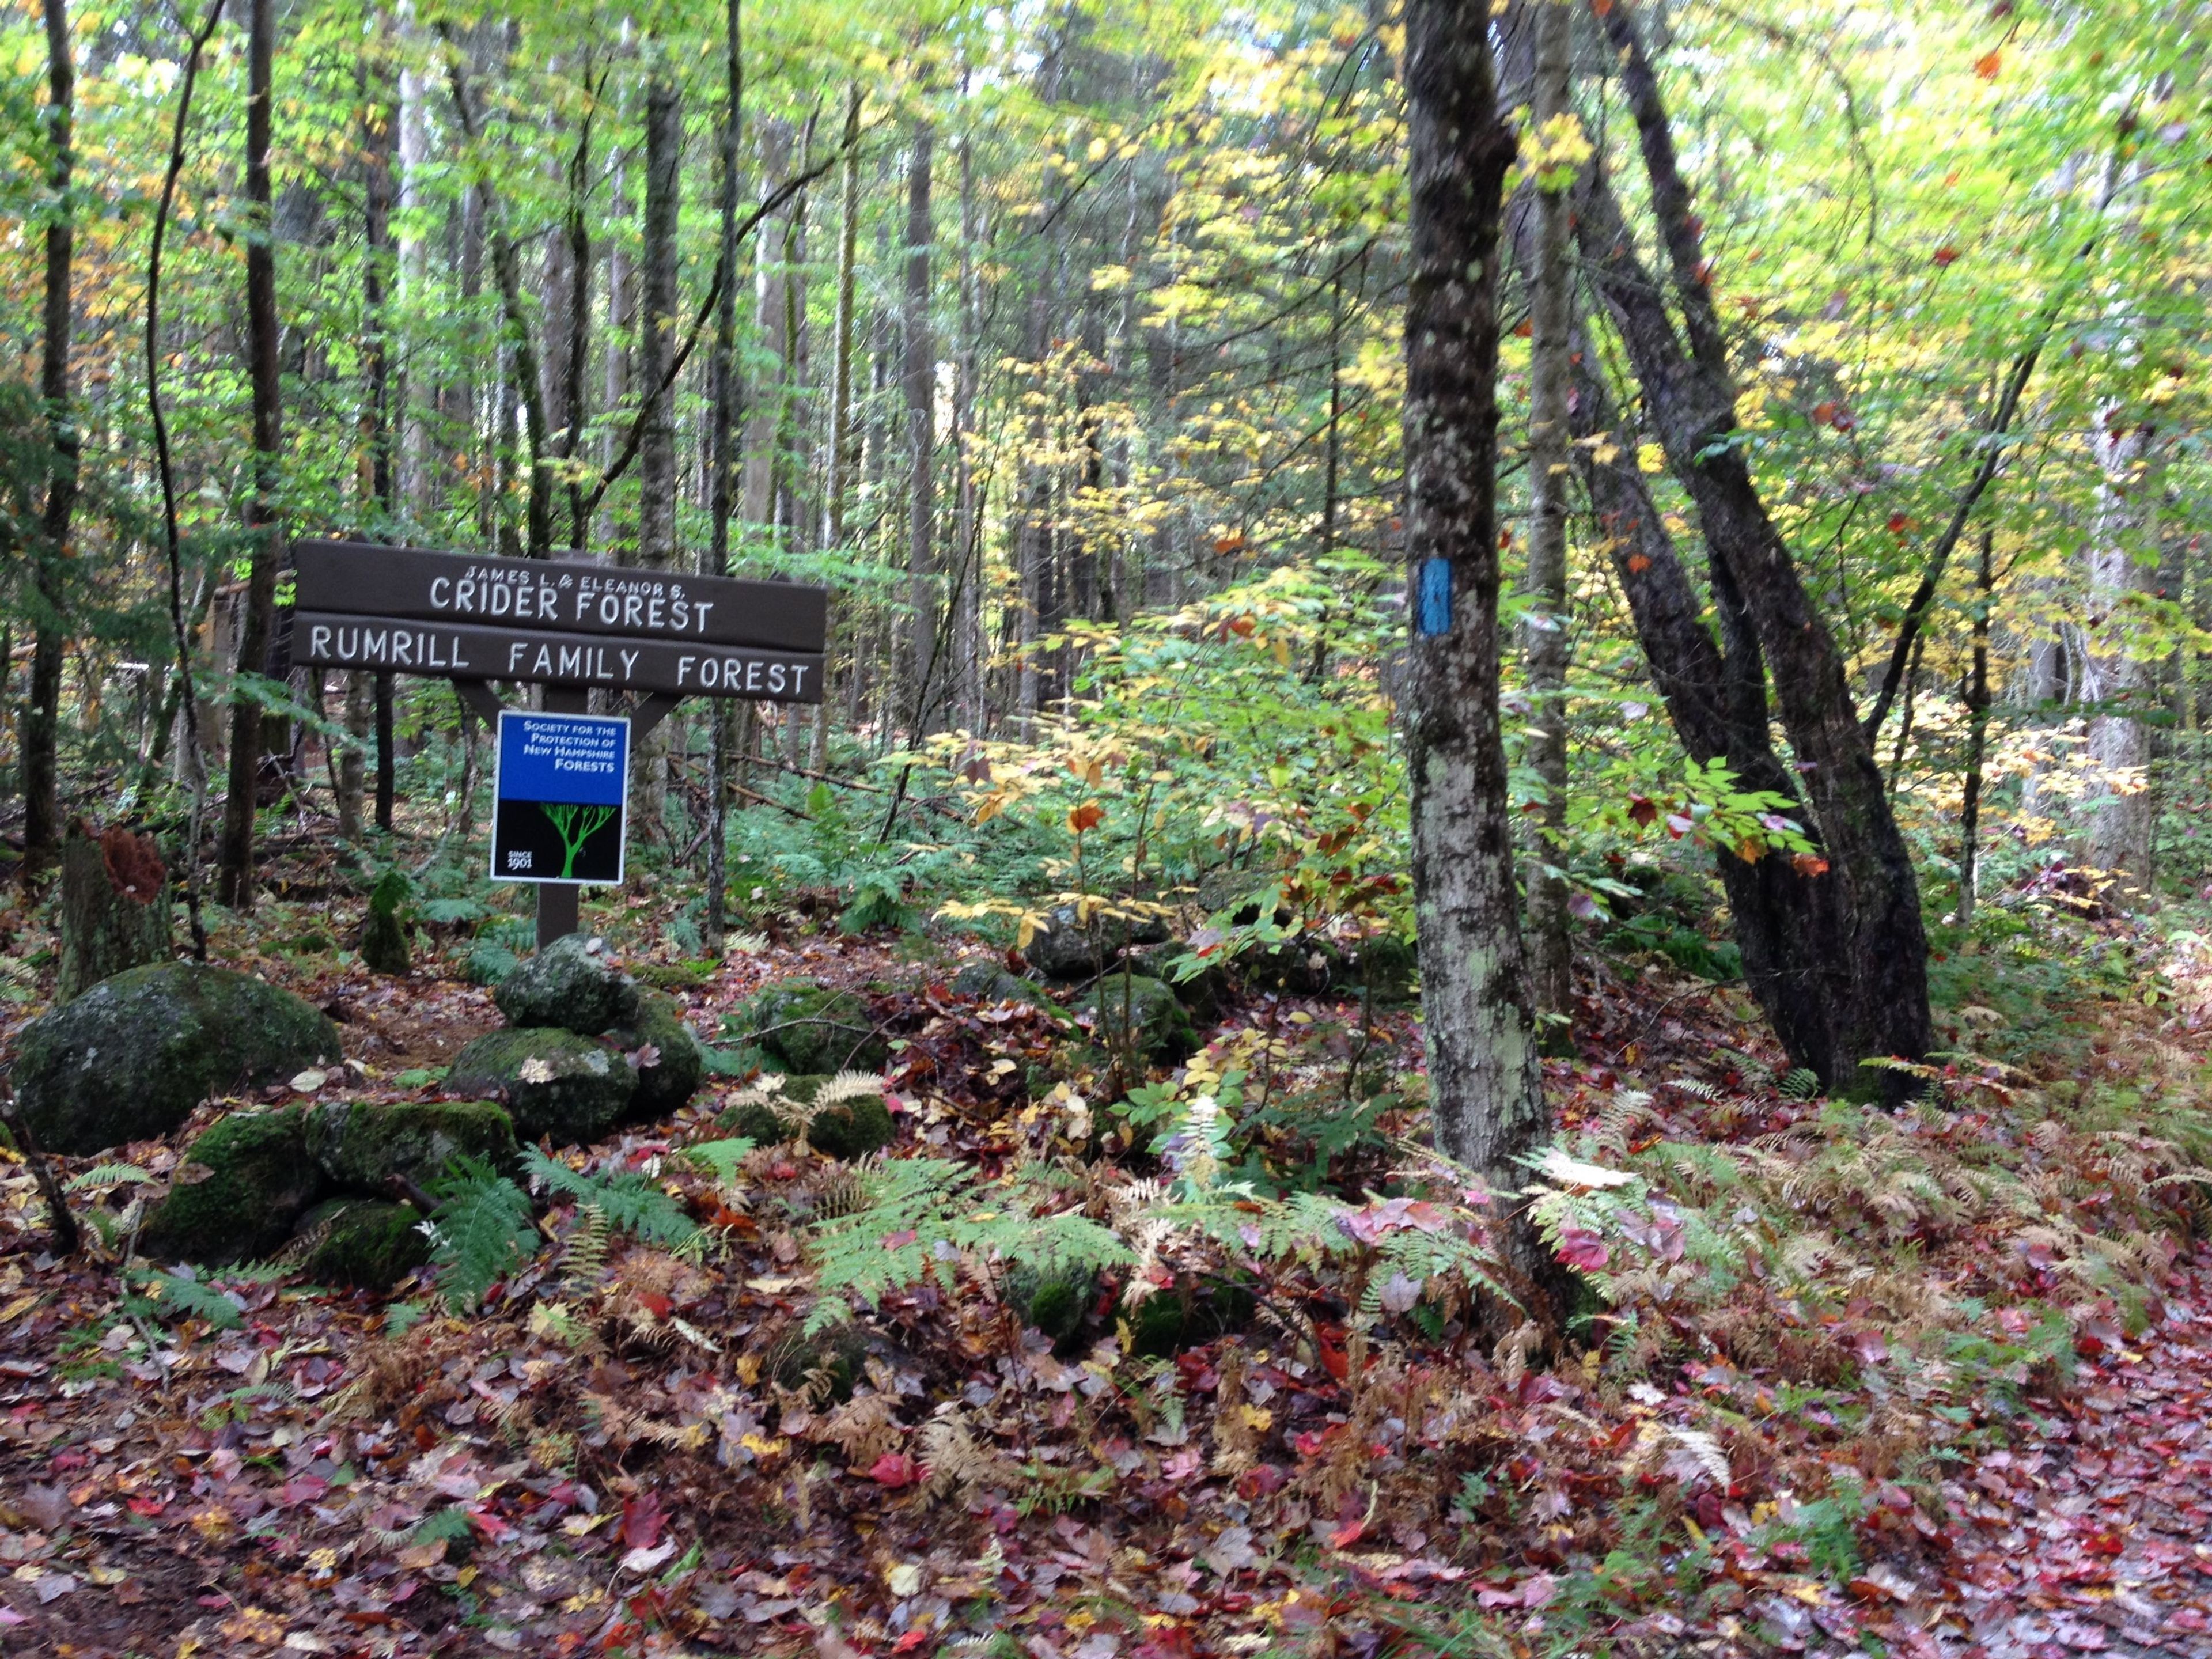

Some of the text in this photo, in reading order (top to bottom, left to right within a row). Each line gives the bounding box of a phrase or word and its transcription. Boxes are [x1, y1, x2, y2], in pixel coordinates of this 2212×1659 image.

[465, 565, 530, 584] JAMES
[559, 574, 573, 589] &
[580, 577, 664, 597] ELEANOR
[430, 577, 714, 633] CRIDER FOREST
[310, 625, 809, 695] RUMRILL FAMILY FOREST
[524, 721, 616, 737] SOCIETY FOR THE
[531, 733, 616, 748] PROTECTION OF
[524, 744, 615, 759] NEW HAMPSHIRE
[555, 758, 615, 772] FORESTS
[507, 850, 532, 859] SINCE
[507, 857, 532, 870] 1901
